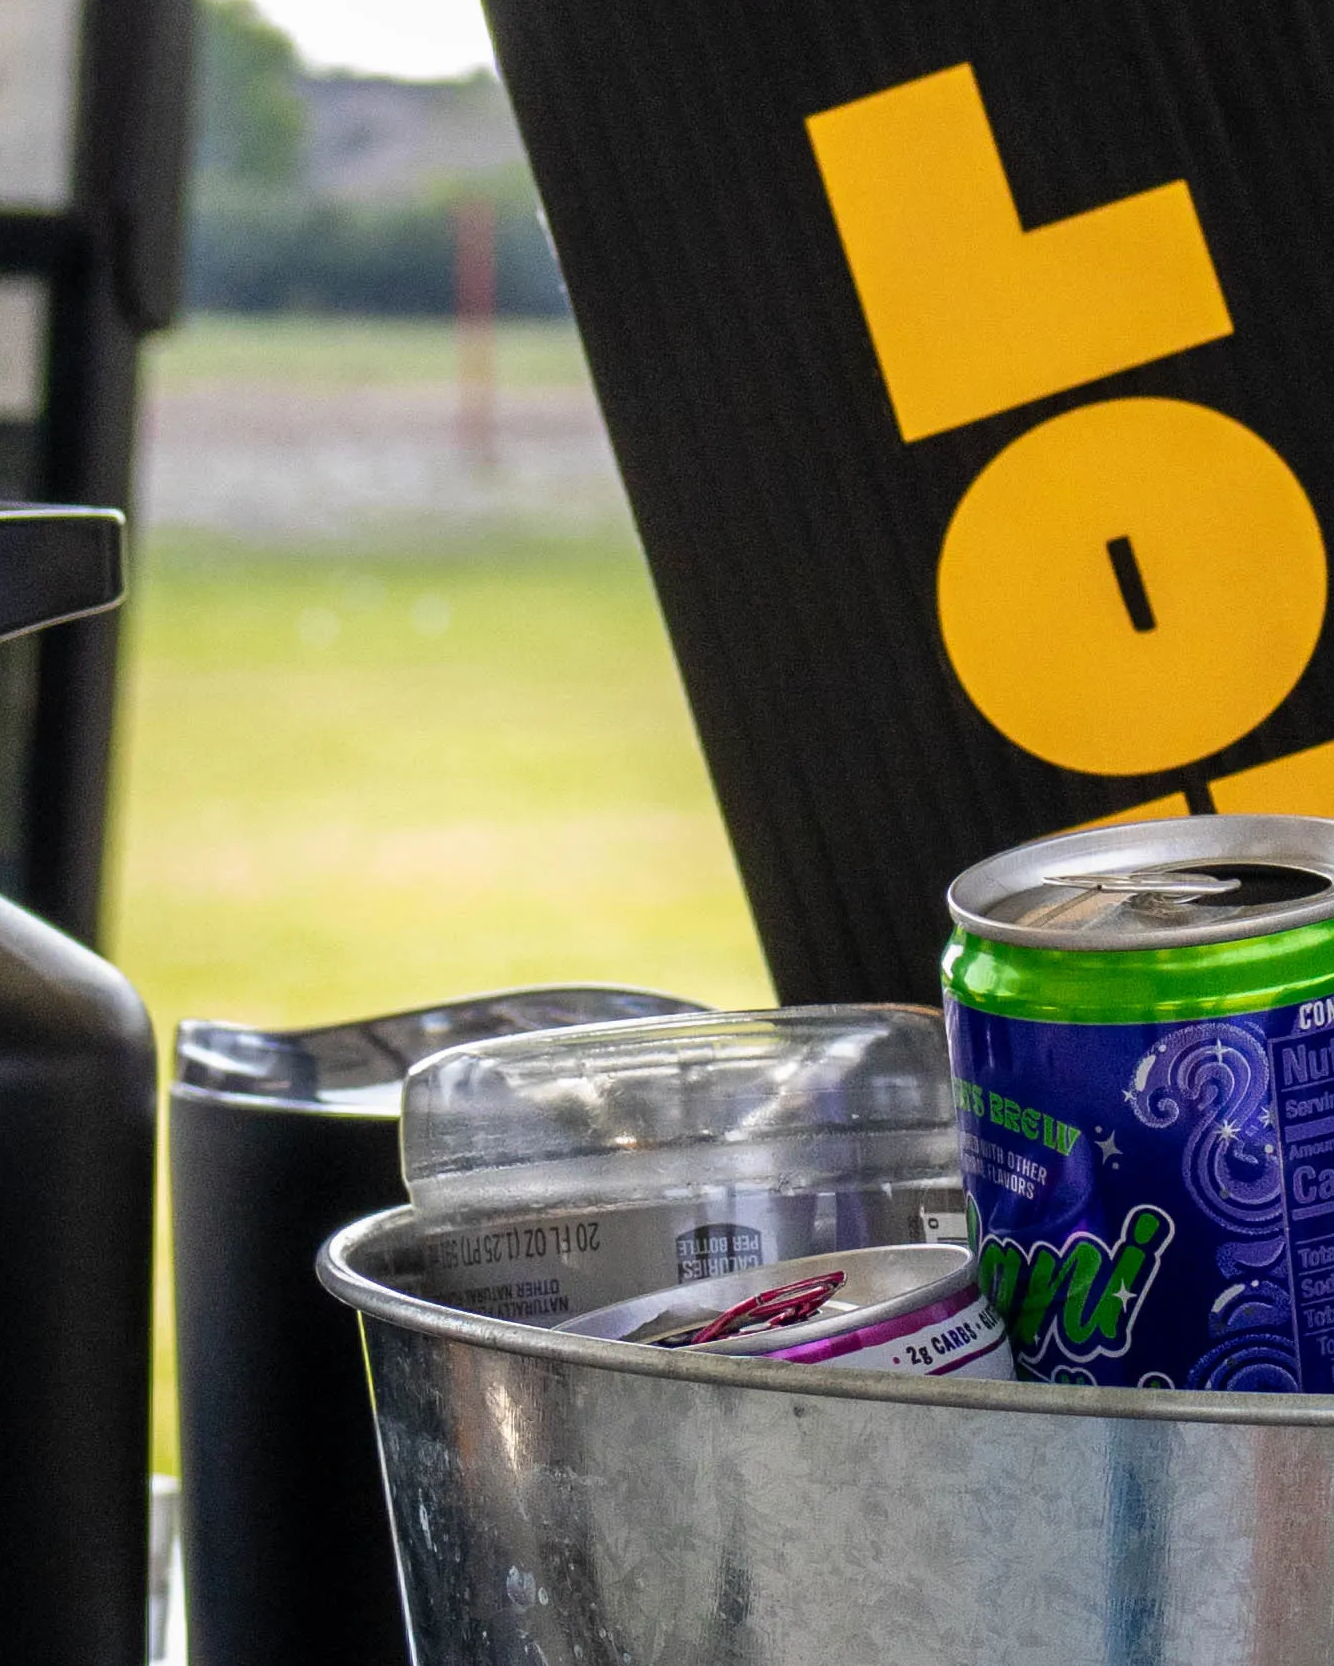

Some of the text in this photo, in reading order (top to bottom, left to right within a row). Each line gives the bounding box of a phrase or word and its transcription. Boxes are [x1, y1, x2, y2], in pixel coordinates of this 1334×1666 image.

[988, 1090, 1082, 1157] BREW
[988, 1163, 1035, 1201] FLAVORS
[1007, 1151, 1048, 1186] OTHER
[522, 1227, 548, 1258] OZ
[549, 1225, 571, 1255] FL
[575, 1221, 601, 1252] 20
[677, 1234, 759, 1256] PER BOTTLE
[514, 1278, 561, 1299] OTHER
[905, 1345, 933, 1366] 2g
[930, 1322, 978, 1355] CARBS
